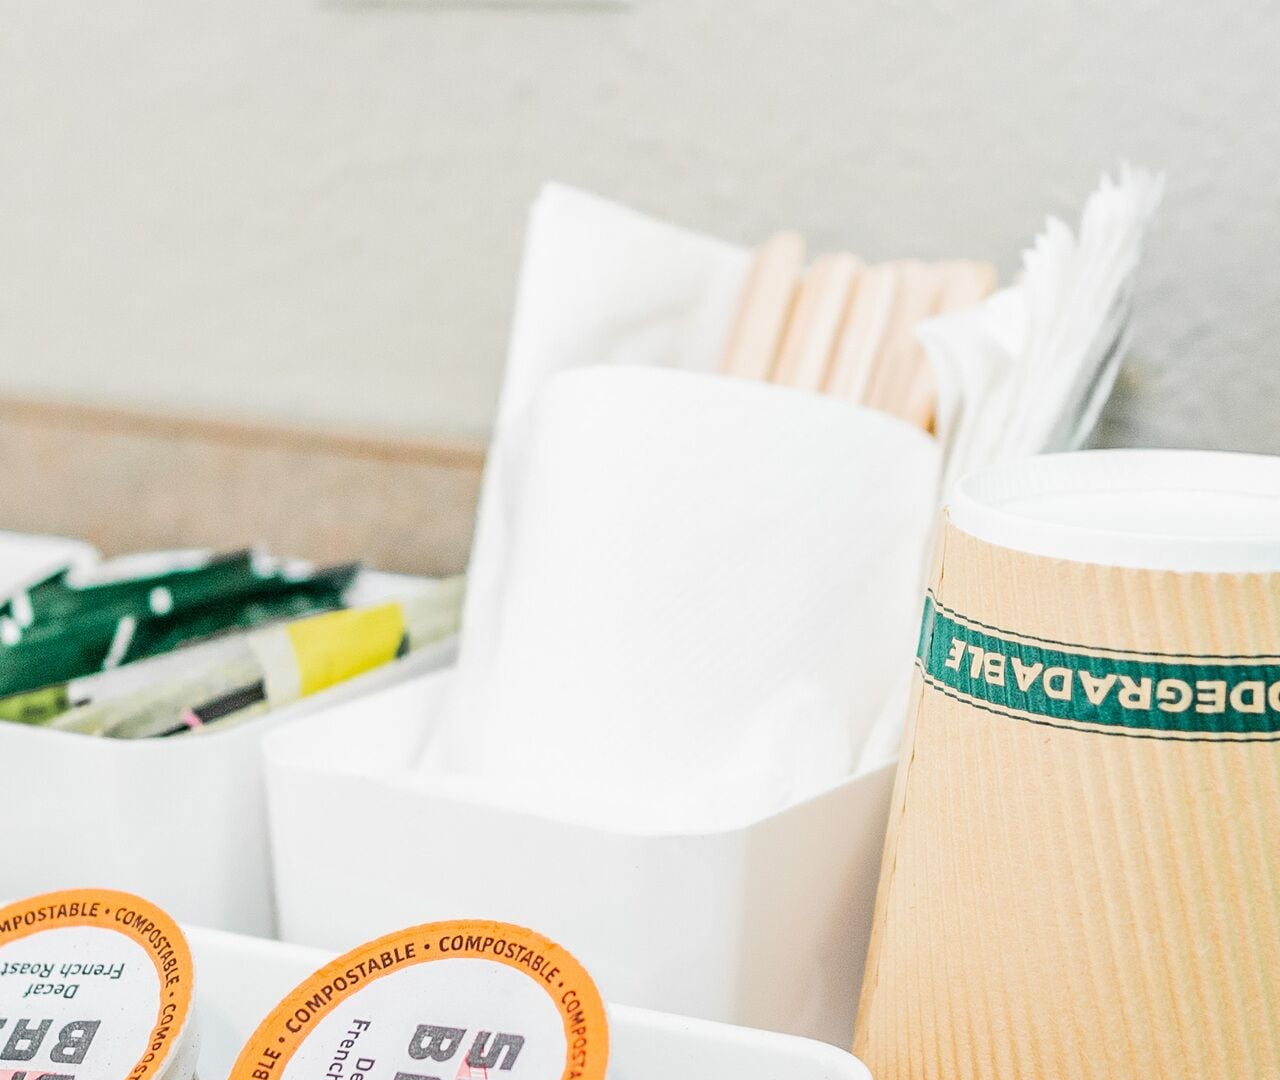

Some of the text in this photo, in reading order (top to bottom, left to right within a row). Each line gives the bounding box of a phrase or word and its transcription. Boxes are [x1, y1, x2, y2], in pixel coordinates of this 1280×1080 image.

[0, 960, 125, 979] French Roast
[114, 906, 181, 989] COMPOSTABLE
[22, 983, 80, 999] Decaf
[285, 942, 417, 1034] COMPOSTABLE
[438, 934, 561, 984] COMPOSTABLE
